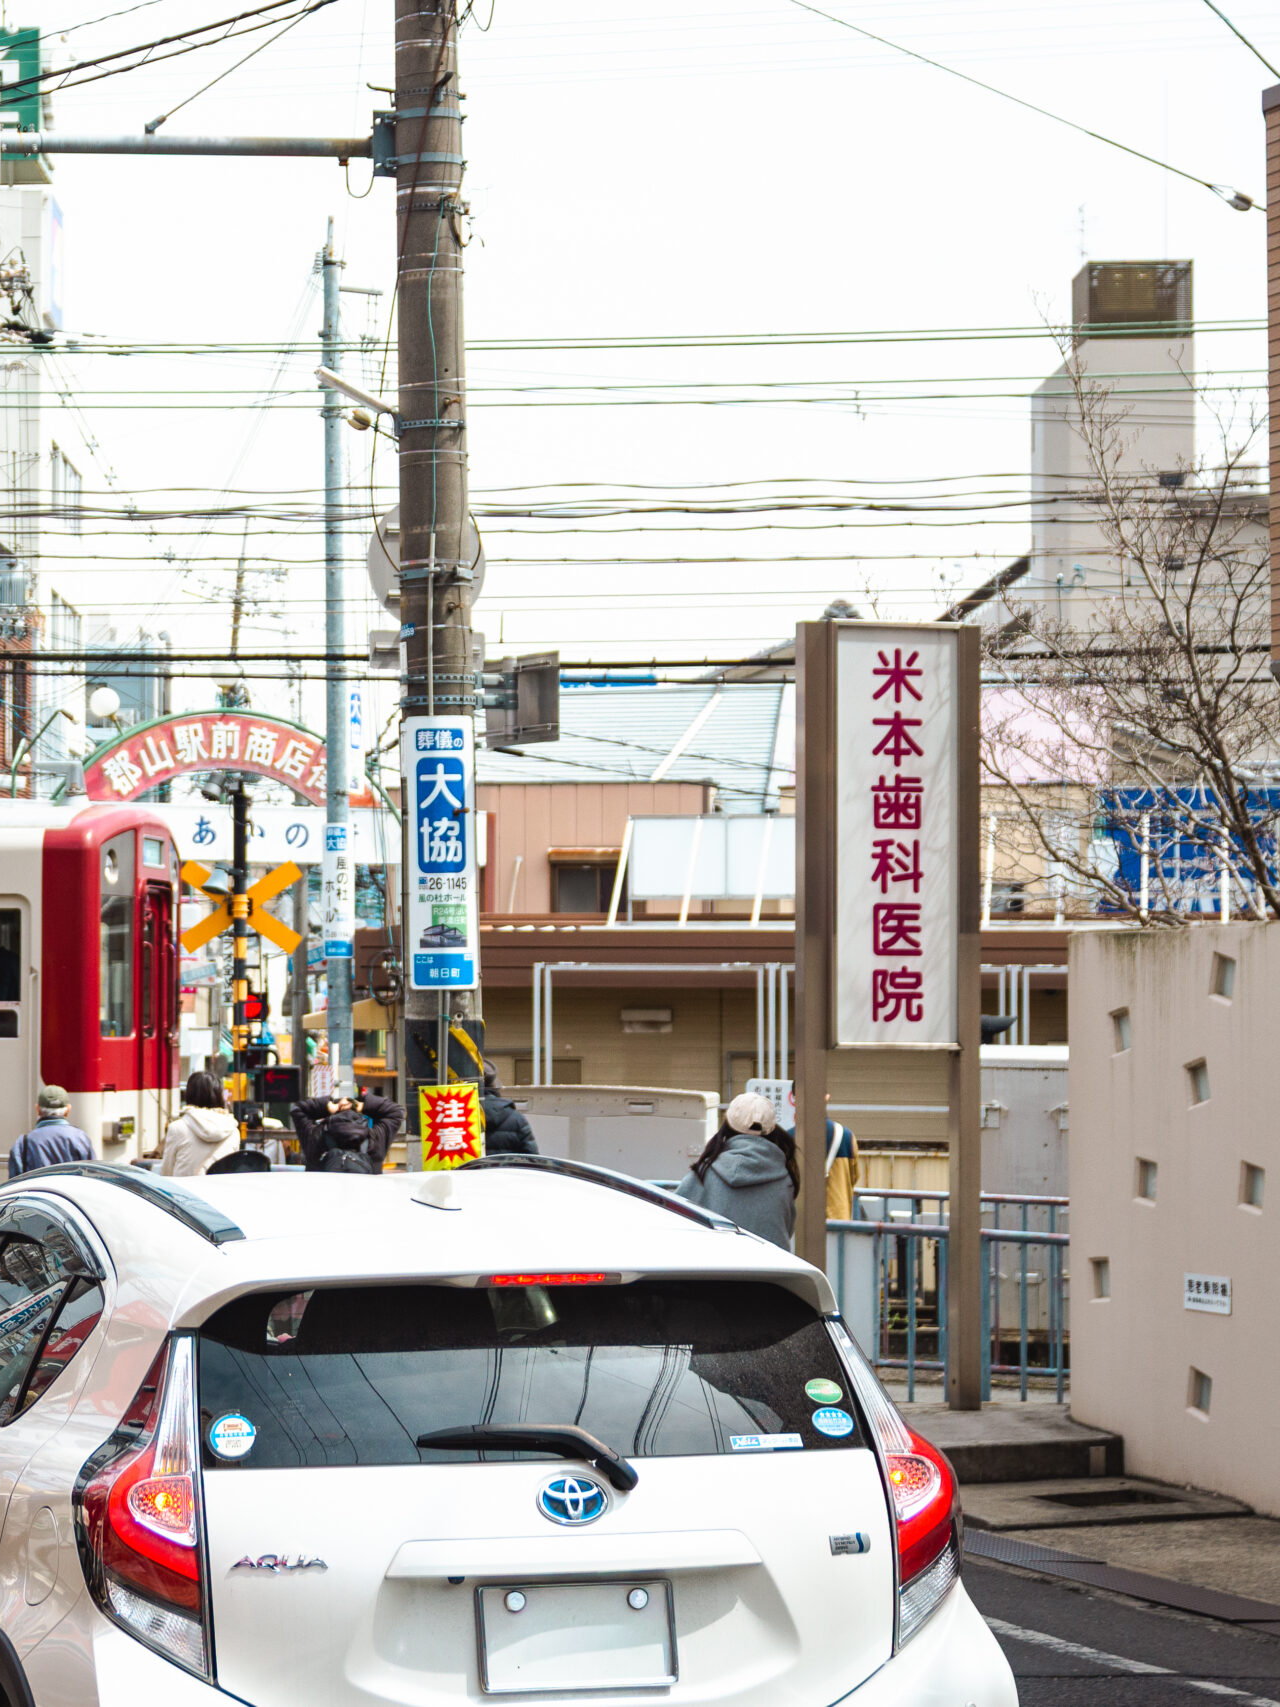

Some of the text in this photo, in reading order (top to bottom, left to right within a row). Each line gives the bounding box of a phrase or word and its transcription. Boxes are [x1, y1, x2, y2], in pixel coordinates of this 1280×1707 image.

[417, 730, 463, 749] 葬儀の
[419, 763, 463, 863] 大協
[871, 648, 925, 1023] 米本歯科医院
[429, 877, 467, 890] 26-1145
[430, 968, 460, 978] 朝日町
[435, 1099, 468, 1151] 注意
[231, 1554, 328, 1573] AQUA
